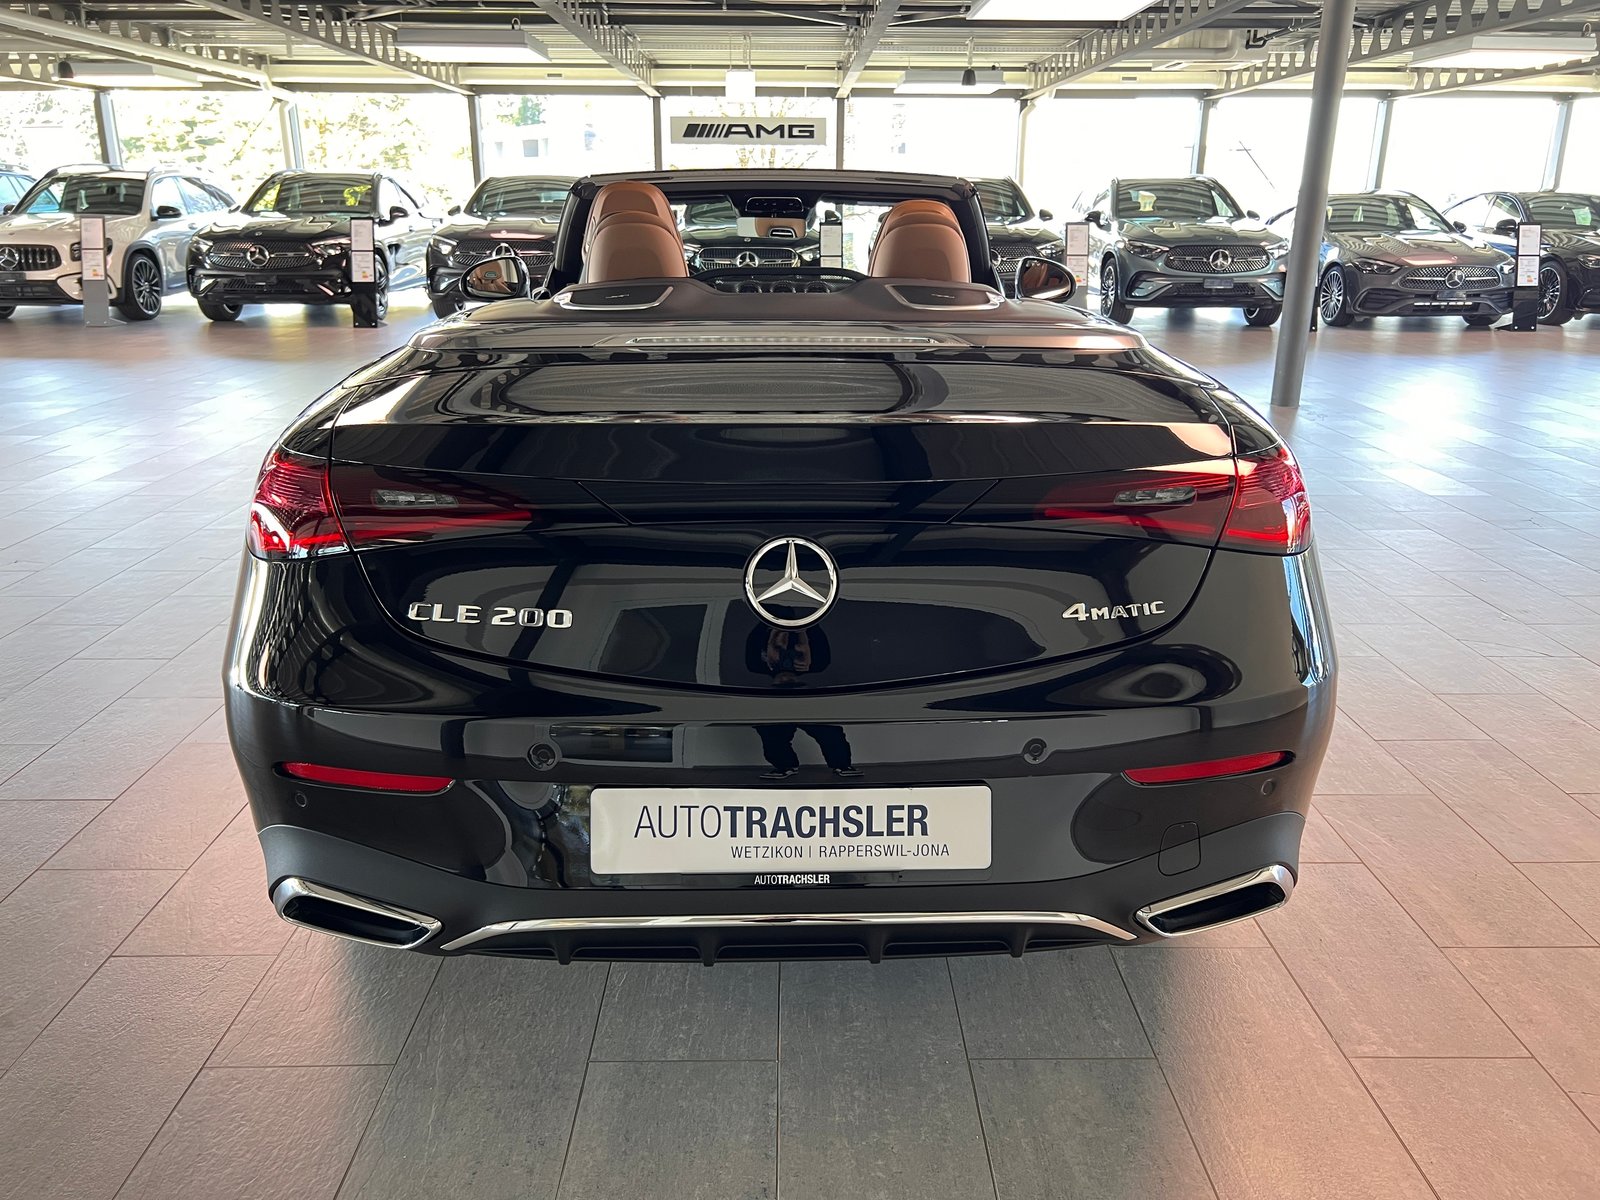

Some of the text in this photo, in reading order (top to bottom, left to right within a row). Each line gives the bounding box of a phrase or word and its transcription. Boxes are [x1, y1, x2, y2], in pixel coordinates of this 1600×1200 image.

[407, 601, 573, 629] CLE 200
[1062, 600, 1166, 621] 4MATIC
[634, 804, 929, 839] AUTOTRACHSLER
[730, 843, 950, 859] WETZIKON RAPPERSWIL-JONA
[754, 873, 831, 885] AUTOTRACHSLER
